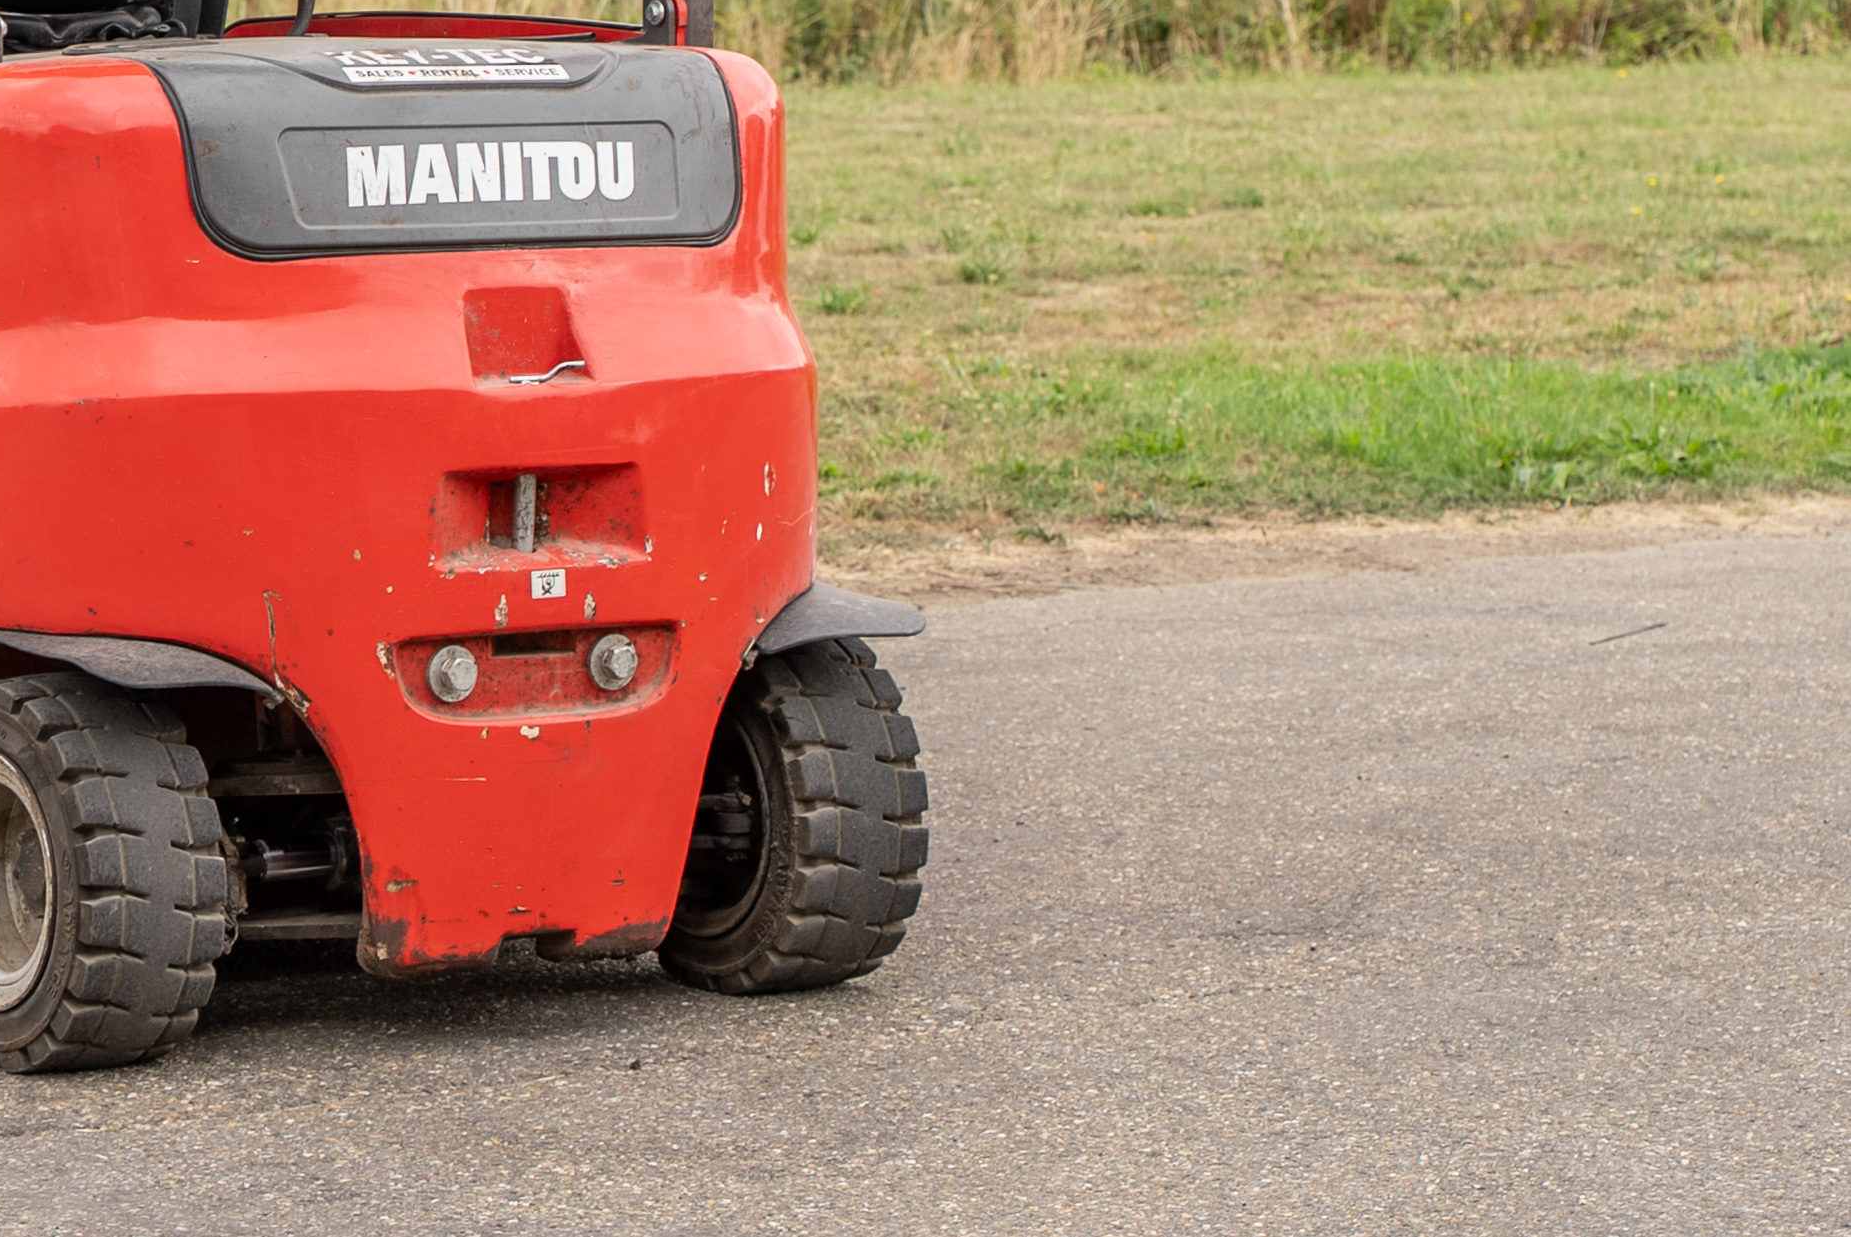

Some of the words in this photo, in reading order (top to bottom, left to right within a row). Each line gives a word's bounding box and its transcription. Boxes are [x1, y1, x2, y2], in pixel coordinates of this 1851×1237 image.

[324, 48, 546, 65] KEY-TEC
[355, 69, 405, 78] SALES
[419, 68, 480, 78] RENTAL
[495, 67, 560, 77] SERVICE
[345, 140, 636, 208] MANITOU
